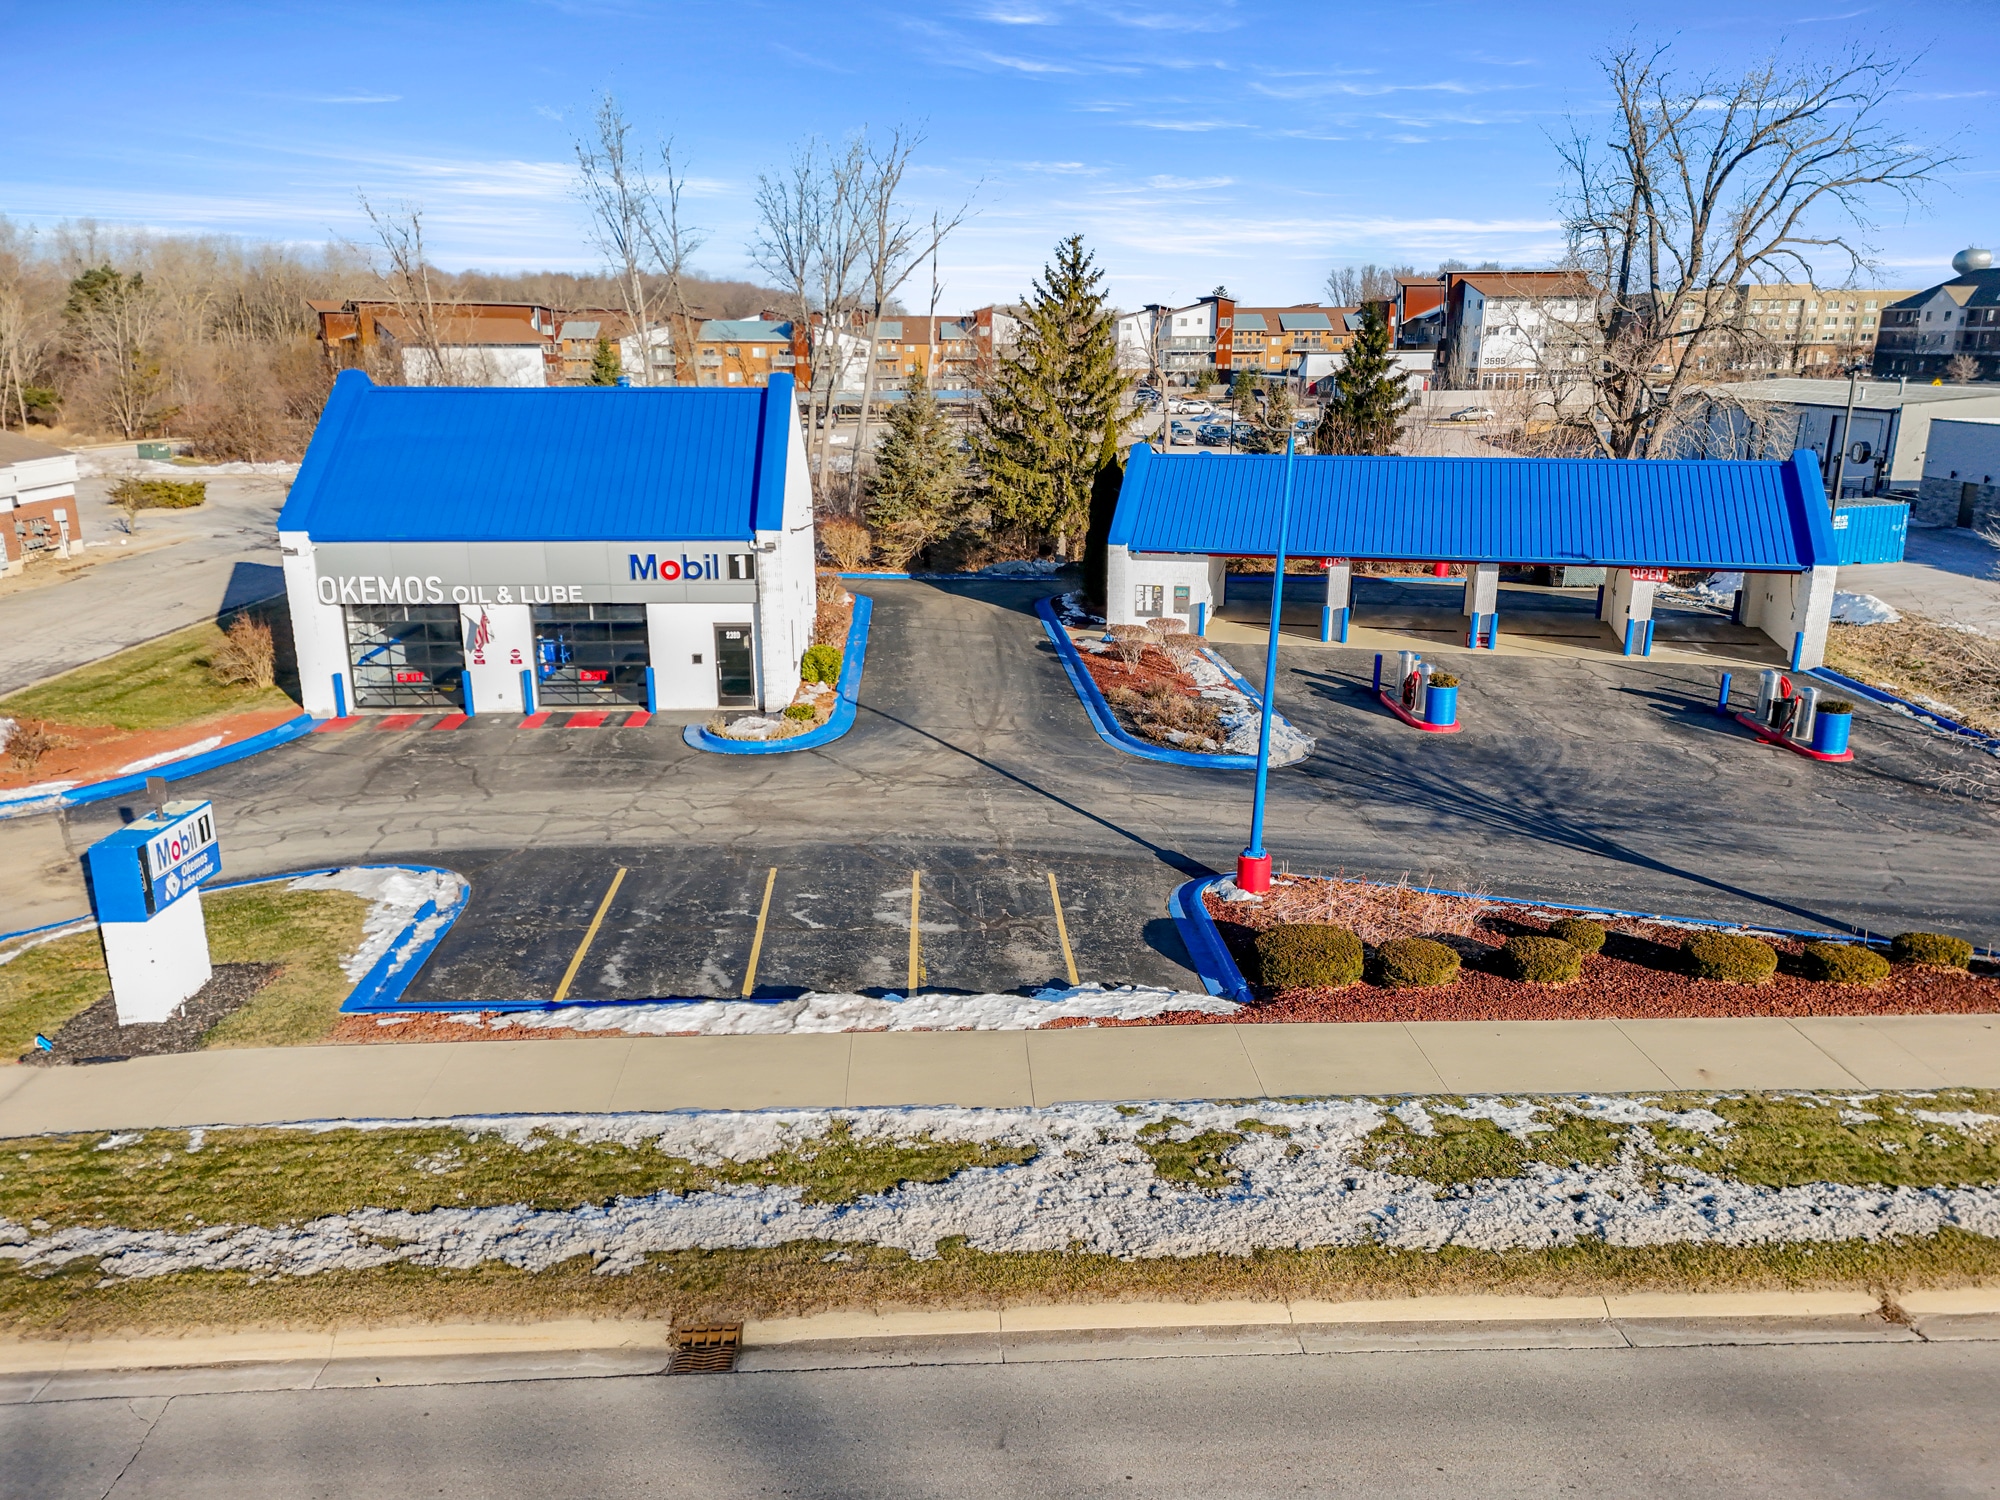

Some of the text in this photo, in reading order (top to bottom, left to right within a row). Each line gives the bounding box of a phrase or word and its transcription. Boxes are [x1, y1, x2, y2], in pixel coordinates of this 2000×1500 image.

[1484, 357, 1506, 365] 3595
[628, 554, 719, 581] Mobil
[1631, 568, 1665, 580] OPEN
[317, 576, 584, 605] OKEMOS OIL & LUBE
[396, 671, 425, 683] EXIT
[580, 669, 609, 681] EXIT
[155, 815, 210, 871] Mobil 1
[181, 852, 208, 877] Okemos
